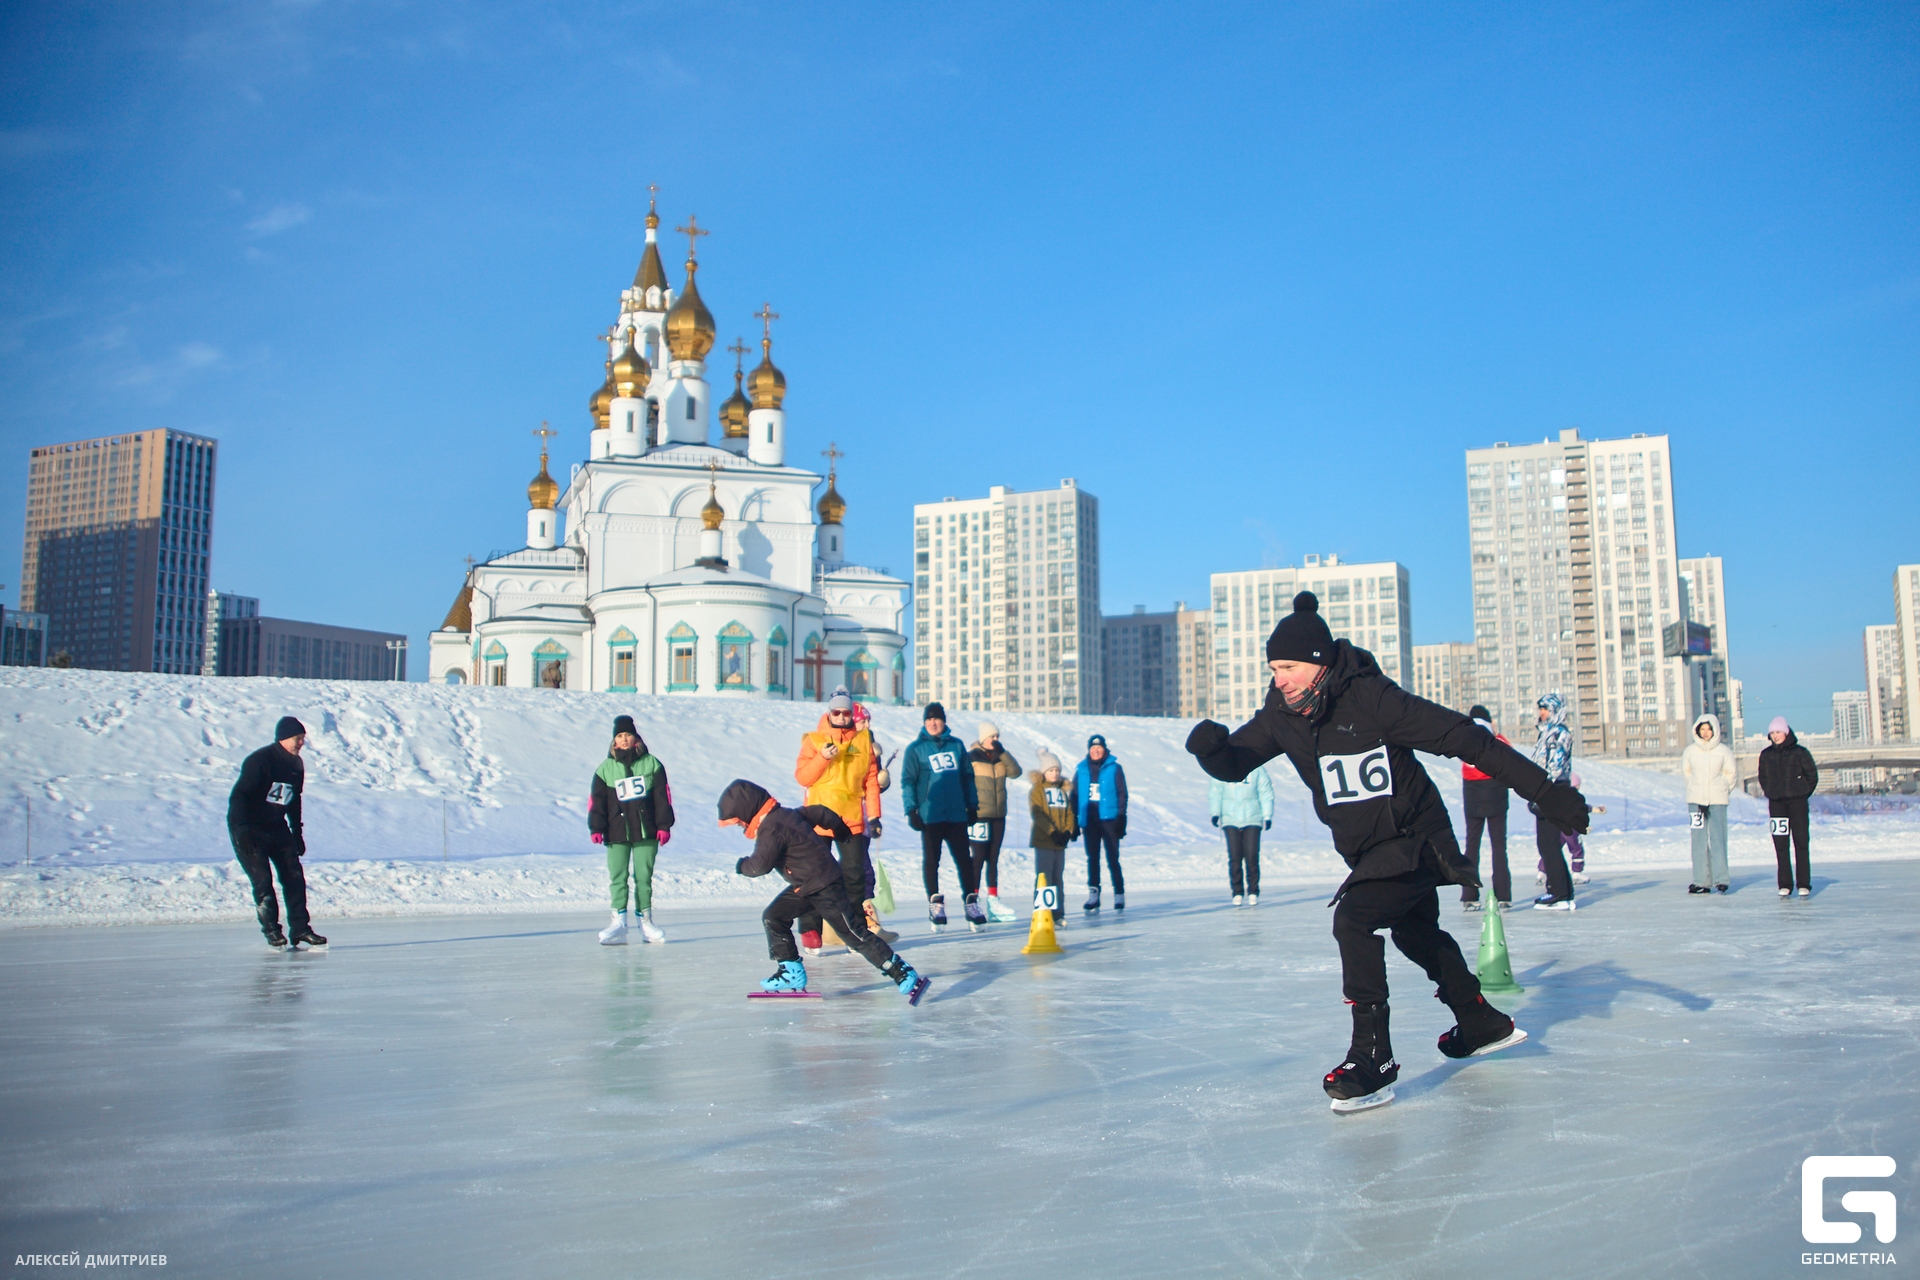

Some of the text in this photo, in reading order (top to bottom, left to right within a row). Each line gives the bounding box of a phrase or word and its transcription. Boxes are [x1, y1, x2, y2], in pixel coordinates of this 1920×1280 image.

[932, 754, 955, 770] 13
[1326, 752, 1390, 799] 16
[618, 778, 645, 798] 15
[1046, 790, 1065, 805] 14
